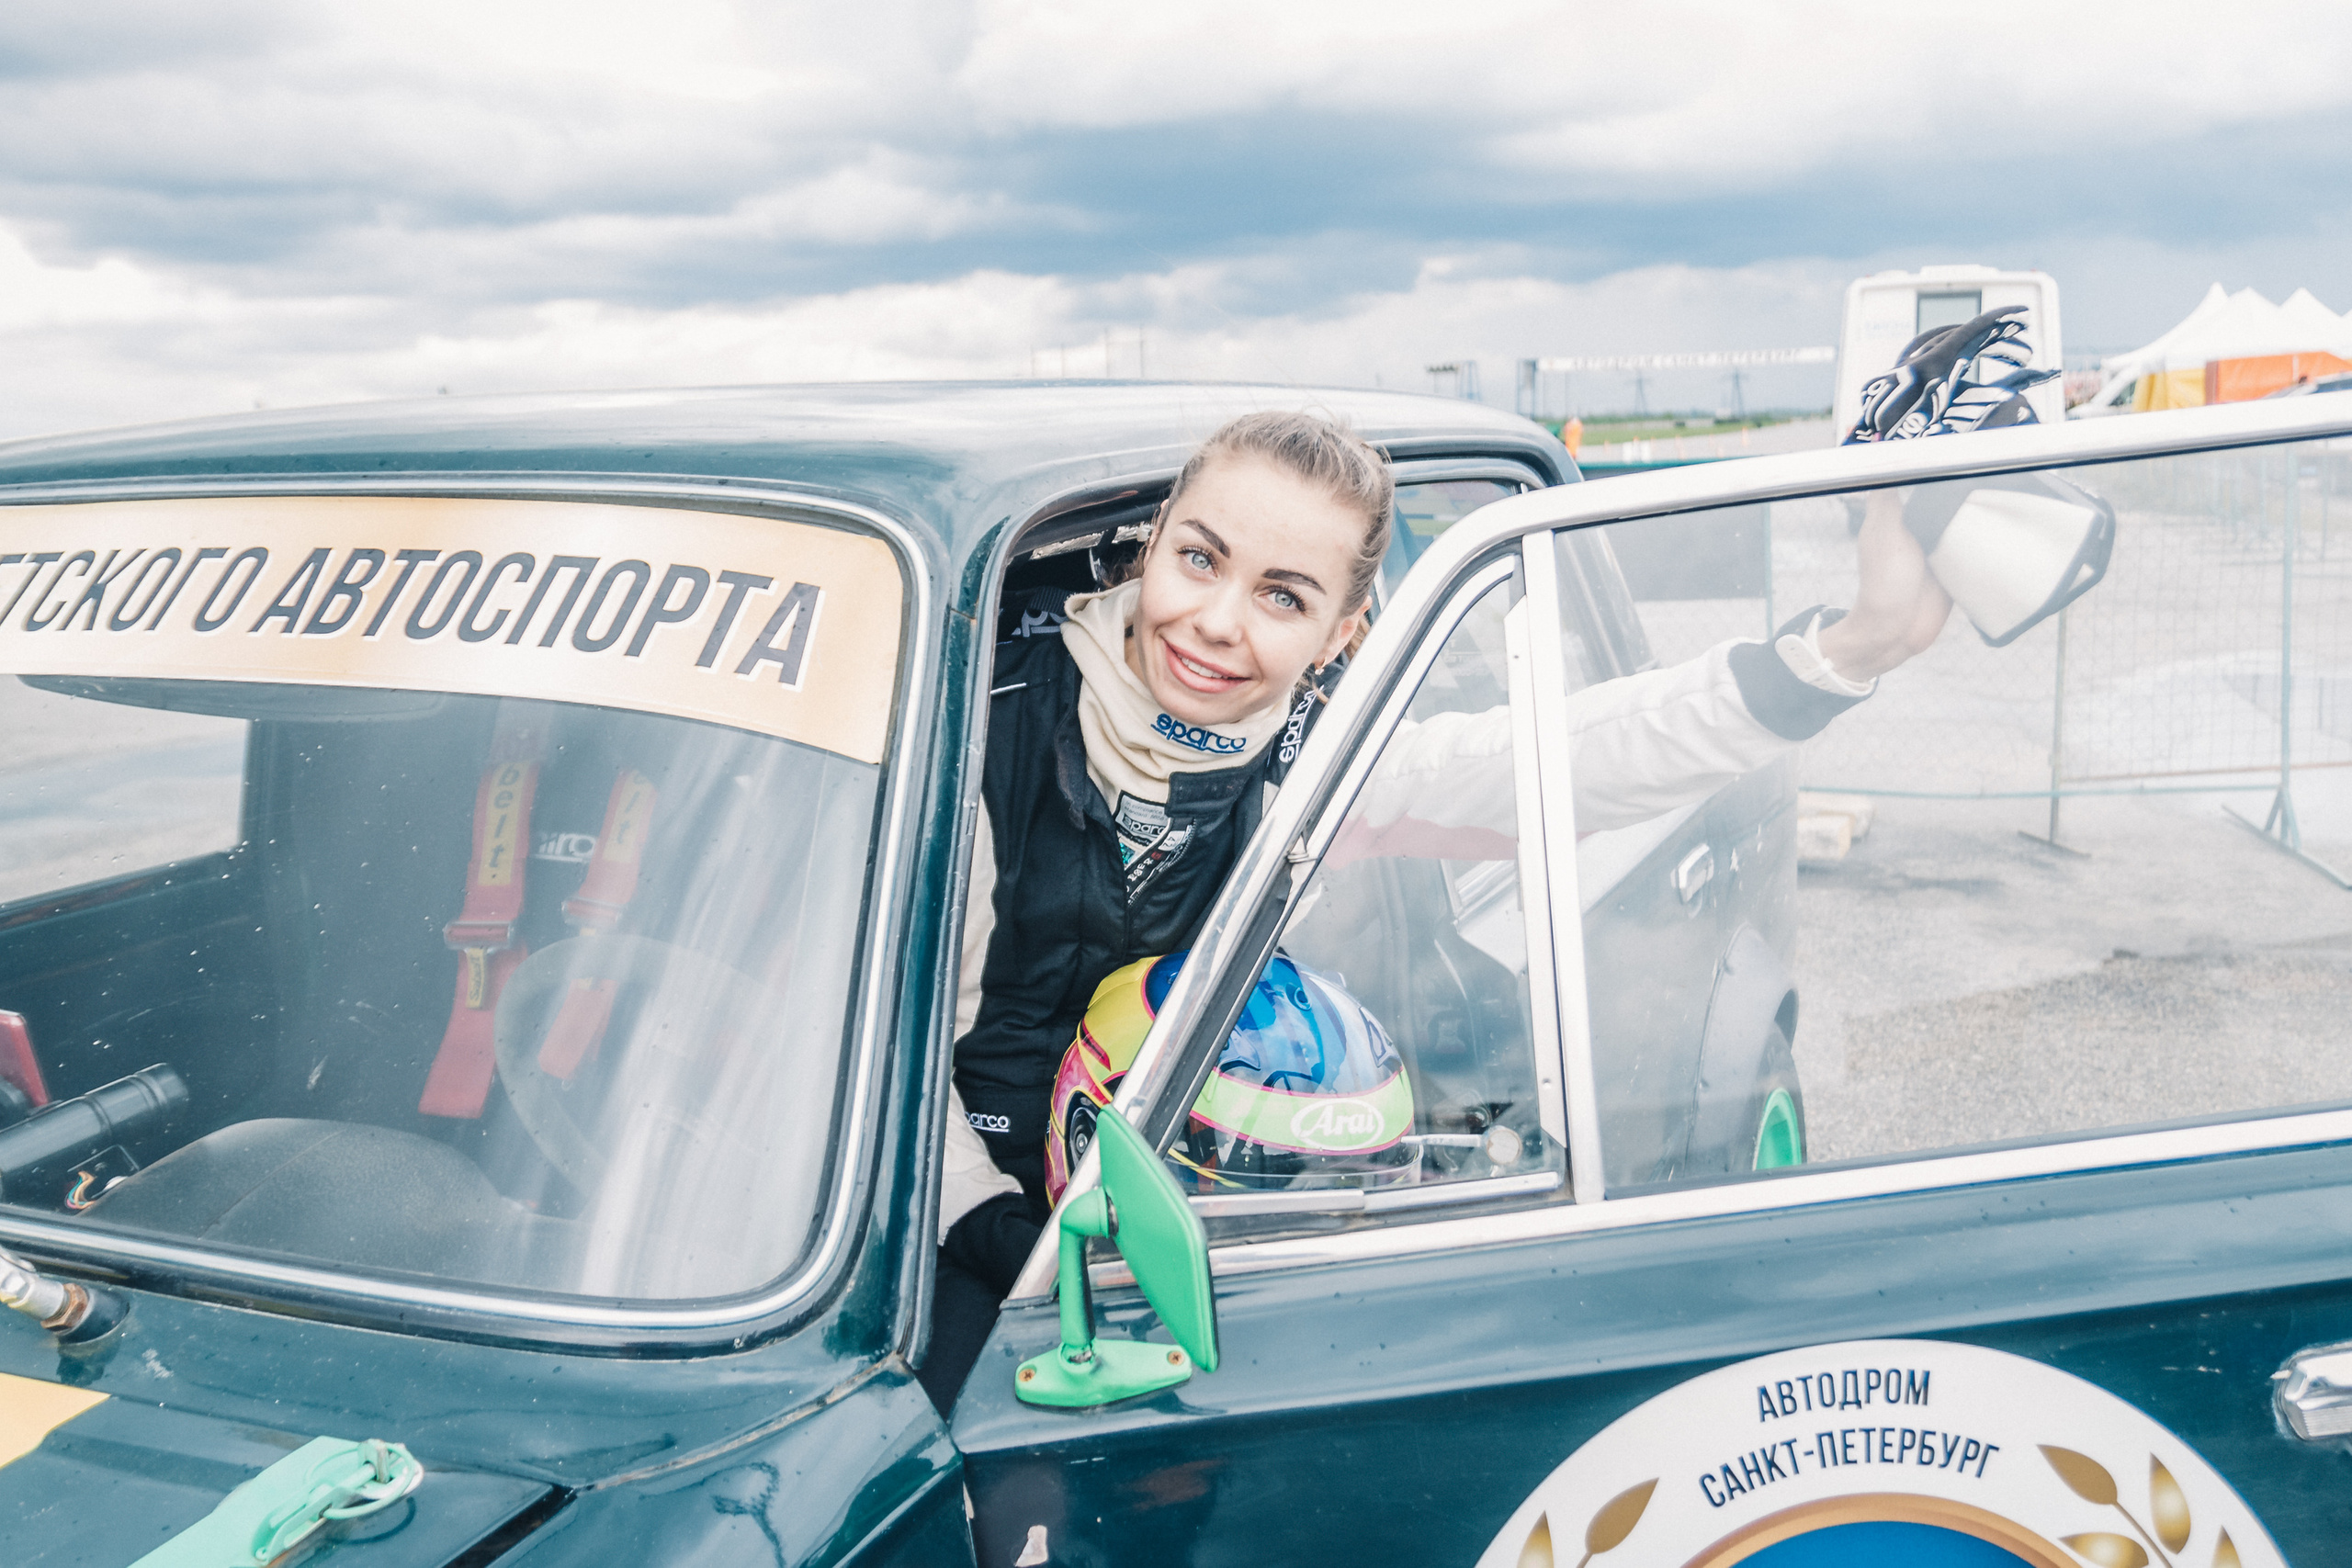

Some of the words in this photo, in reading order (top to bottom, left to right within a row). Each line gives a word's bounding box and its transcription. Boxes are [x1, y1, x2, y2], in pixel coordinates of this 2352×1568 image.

[0, 547, 269, 633] ТСКОГО
[247, 547, 822, 687] АВТОСПОРТА
[1151, 713, 1247, 753] sparco
[1300, 1103, 1375, 1138] Arai
[1756, 1368, 1931, 1423] АВТОДРОМ
[1698, 1427, 2000, 1508] САНКТ-ПЕТЕРБУРГ
